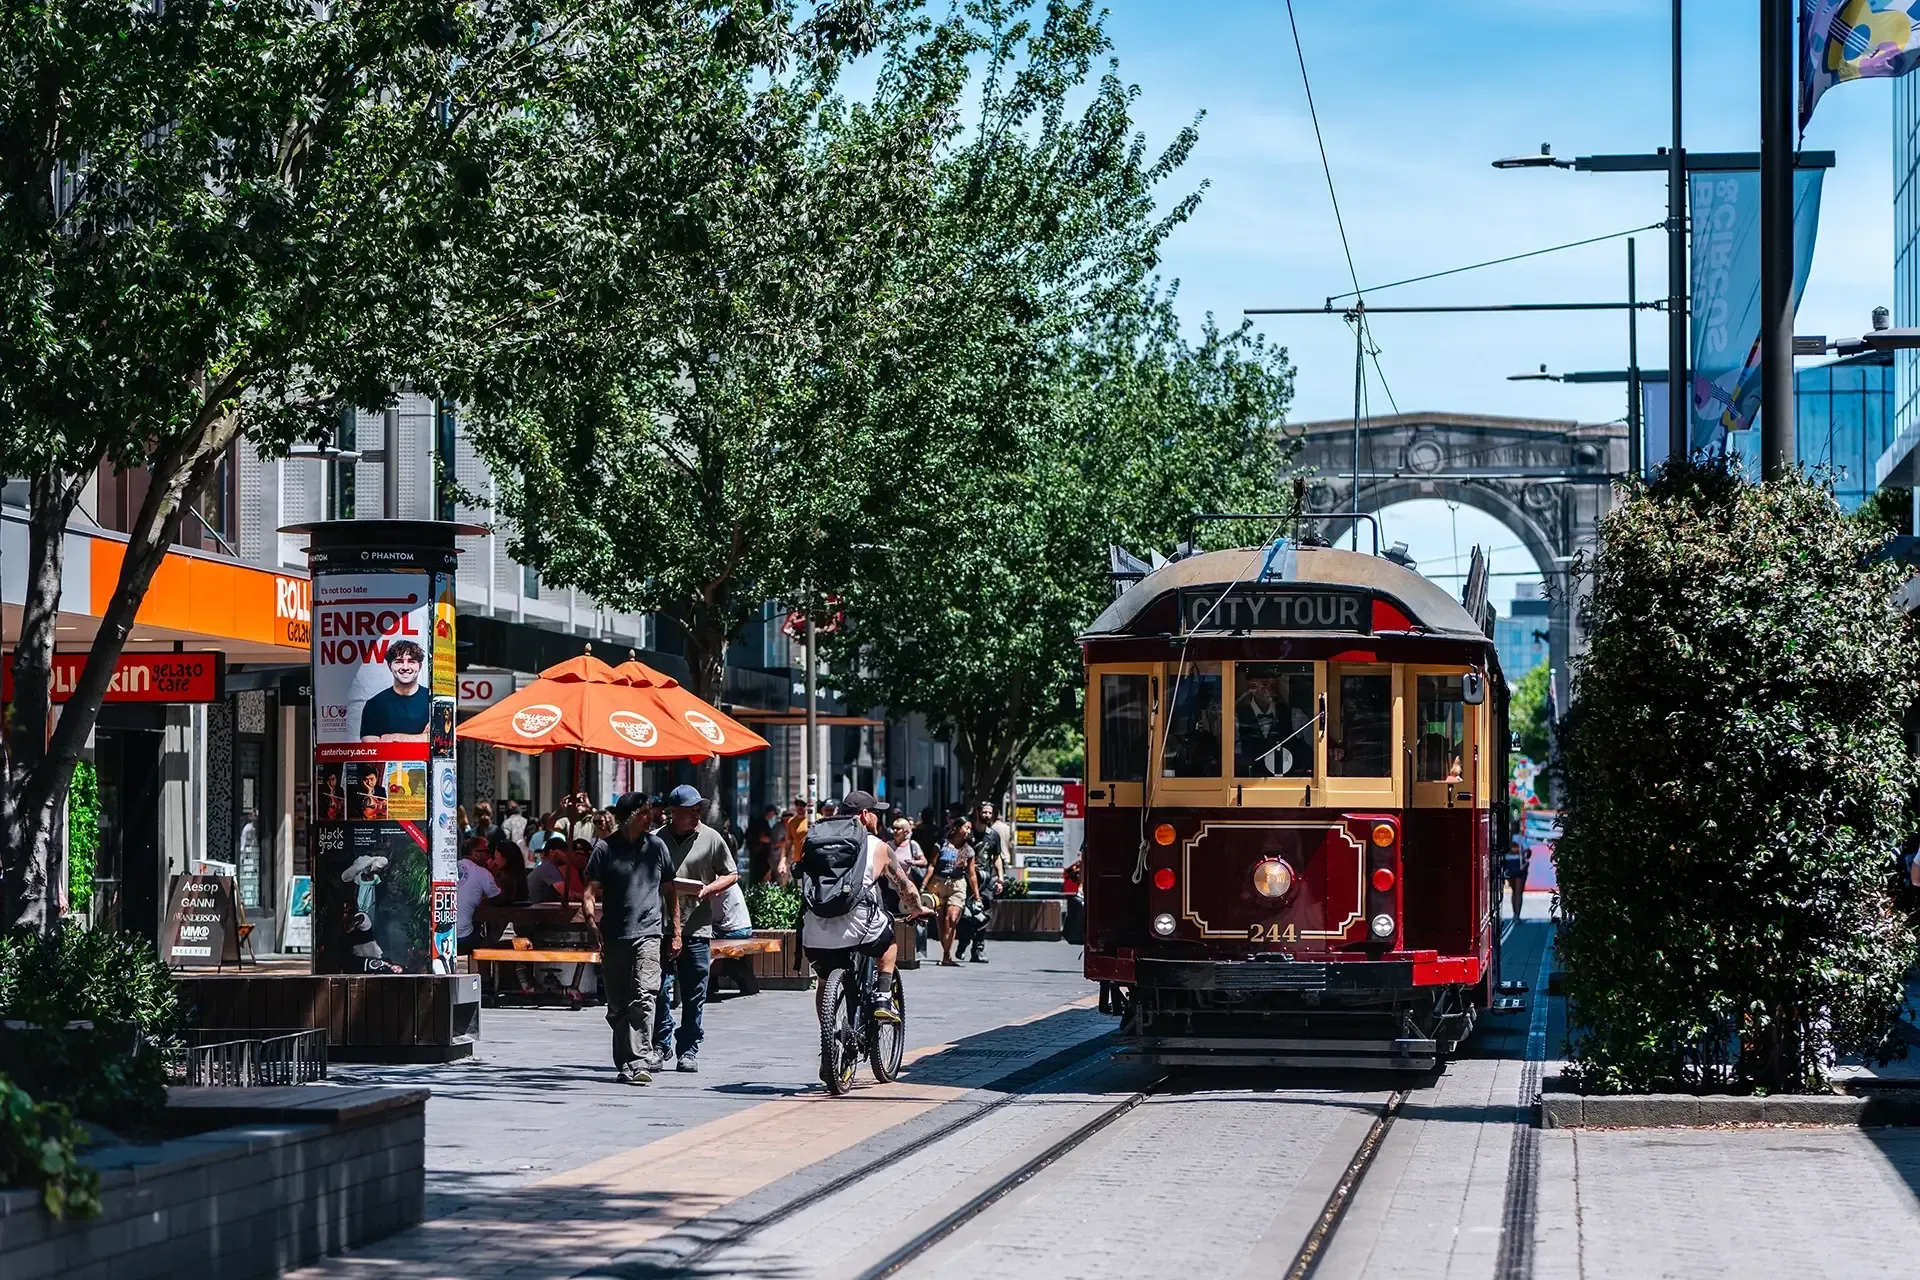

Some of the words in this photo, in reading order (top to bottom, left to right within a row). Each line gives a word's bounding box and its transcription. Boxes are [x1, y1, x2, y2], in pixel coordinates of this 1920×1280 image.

[309, 554, 328, 562] ANTOM
[371, 552, 414, 560] PHANTOM
[353, 586, 368, 594] late
[1192, 597, 1267, 626] CITY
[1274, 596, 1361, 626] TOUR
[321, 610, 419, 637] ENROL
[321, 639, 391, 666] NOW
[158, 679, 189, 693] cafe
[321, 705, 338, 718] UC
[321, 748, 377, 757] canterbury.ac.nz
[1016, 783, 1064, 796] RIVERSID
[319, 827, 344, 840] black
[182, 881, 219, 895] Aesop
[181, 897, 215, 908] GANNI
[1250, 924, 1297, 944] 244
